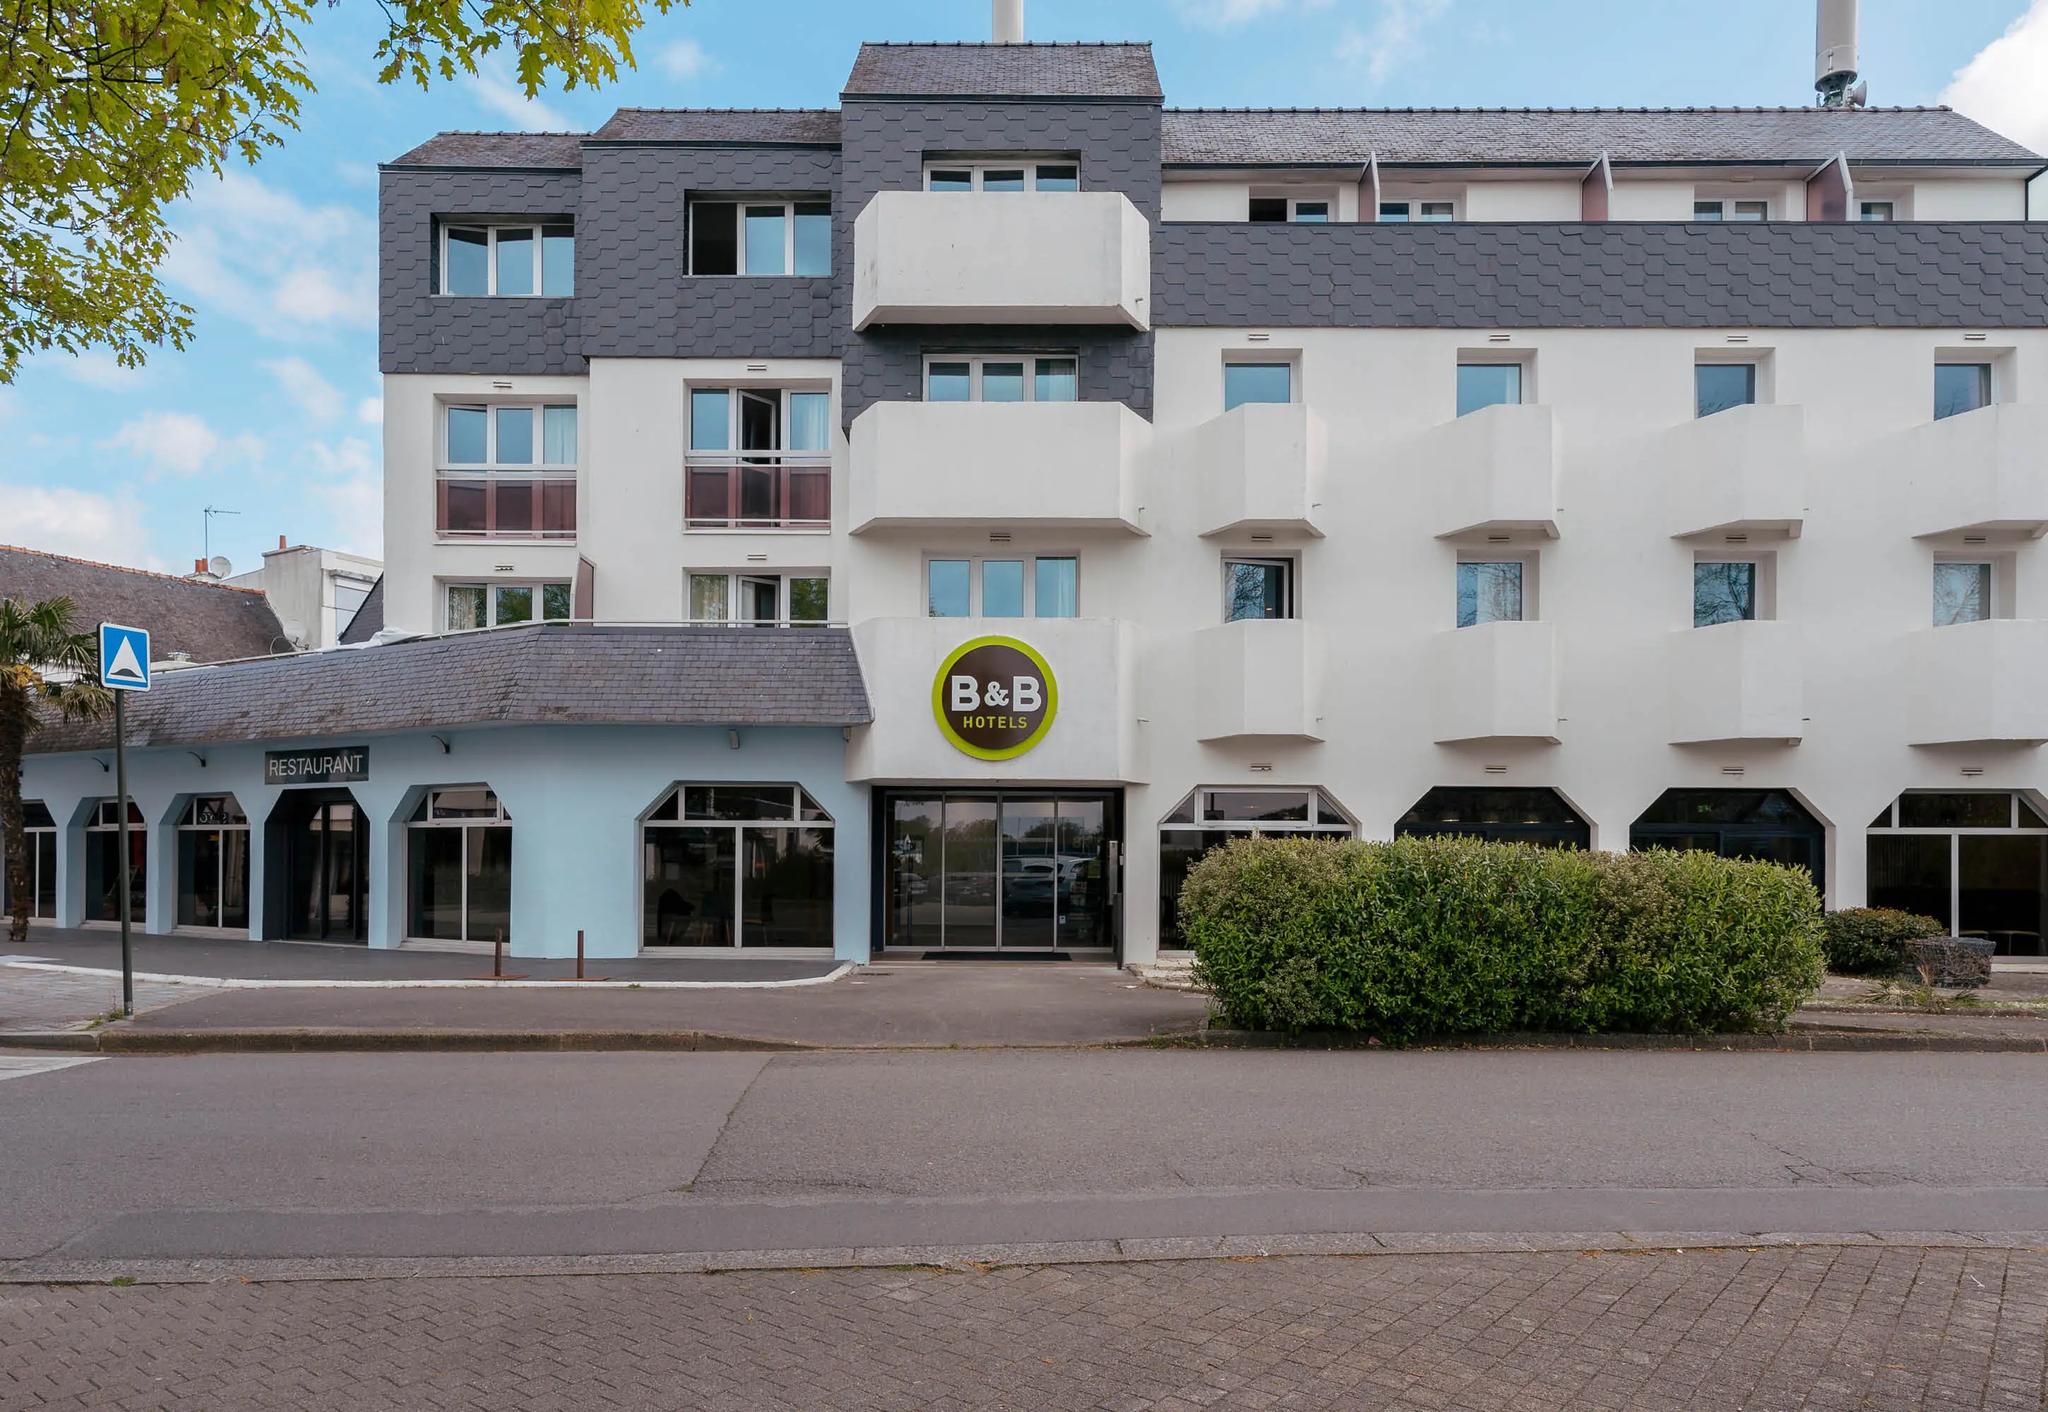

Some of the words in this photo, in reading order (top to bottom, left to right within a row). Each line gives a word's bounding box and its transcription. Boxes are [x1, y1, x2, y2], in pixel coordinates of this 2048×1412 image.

[951, 675, 1042, 712] B&B
[963, 716, 1028, 729] HOTELS
[269, 754, 363, 777] RESTAURANT
